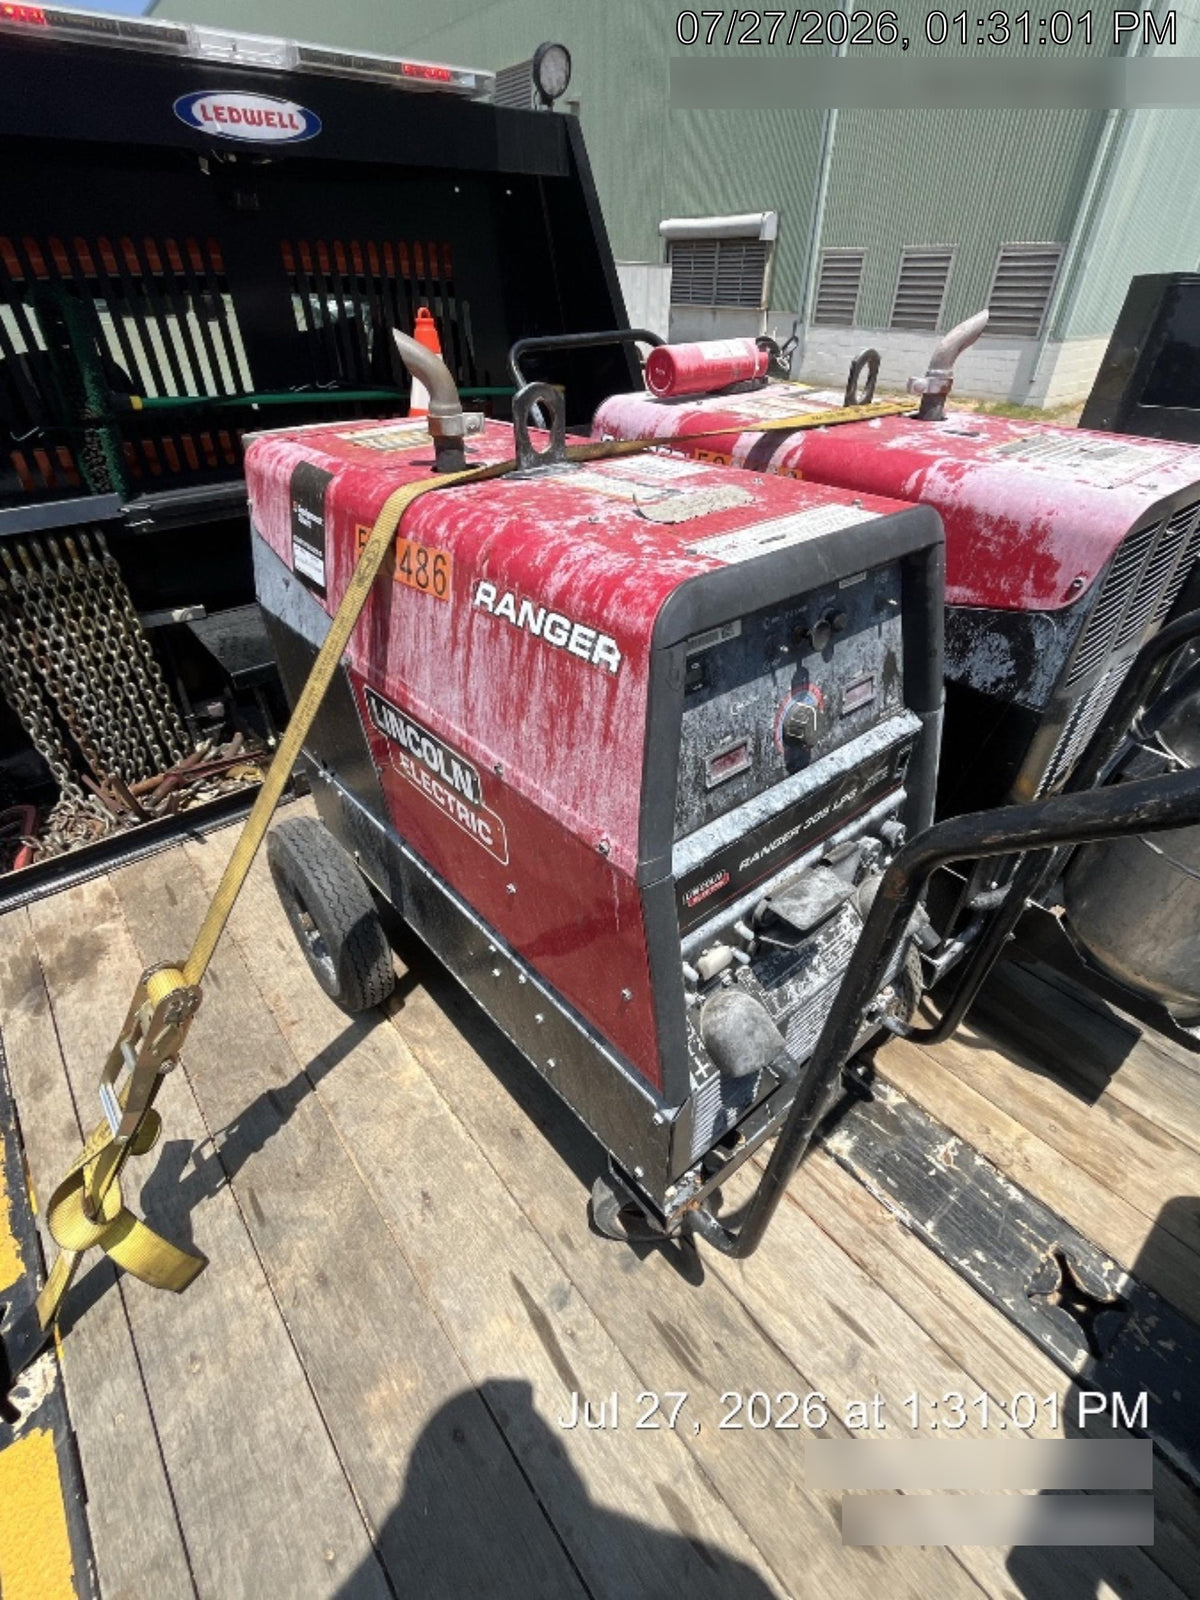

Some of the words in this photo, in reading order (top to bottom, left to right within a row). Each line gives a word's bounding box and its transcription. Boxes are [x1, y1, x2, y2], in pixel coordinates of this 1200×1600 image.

[200, 104, 300, 130] LEDWELL
[473, 580, 622, 675] RANGER
[398, 752, 494, 846] ELECTRIC
